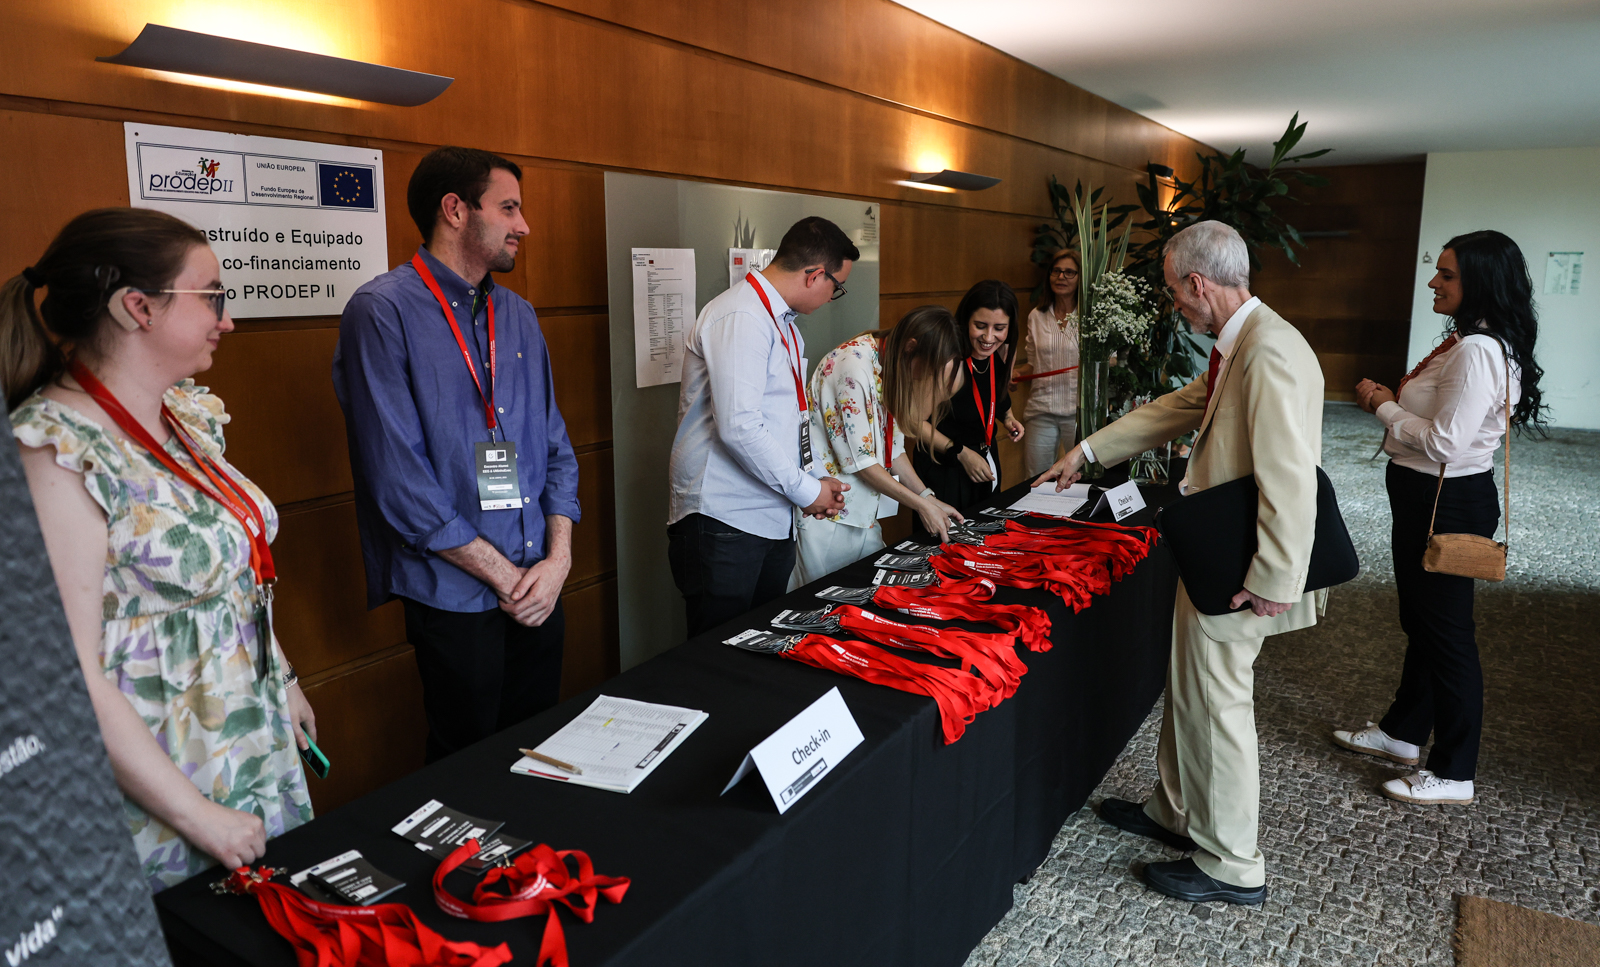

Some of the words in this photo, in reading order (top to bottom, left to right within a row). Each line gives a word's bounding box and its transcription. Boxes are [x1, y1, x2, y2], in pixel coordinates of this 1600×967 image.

[256, 162, 275, 170] UNIÃO
[276, 164, 306, 172] EUROPEIA
[251, 190, 293, 199] Desenvolvimento
[293, 193, 315, 201] Regional
[275, 231, 285, 243] e
[291, 229, 363, 248] Equipado
[222, 255, 361, 271] co-financiamento
[243, 284, 321, 300] PRODEP
[326, 284, 335, 298] II
[791, 729, 831, 765] Check-in
